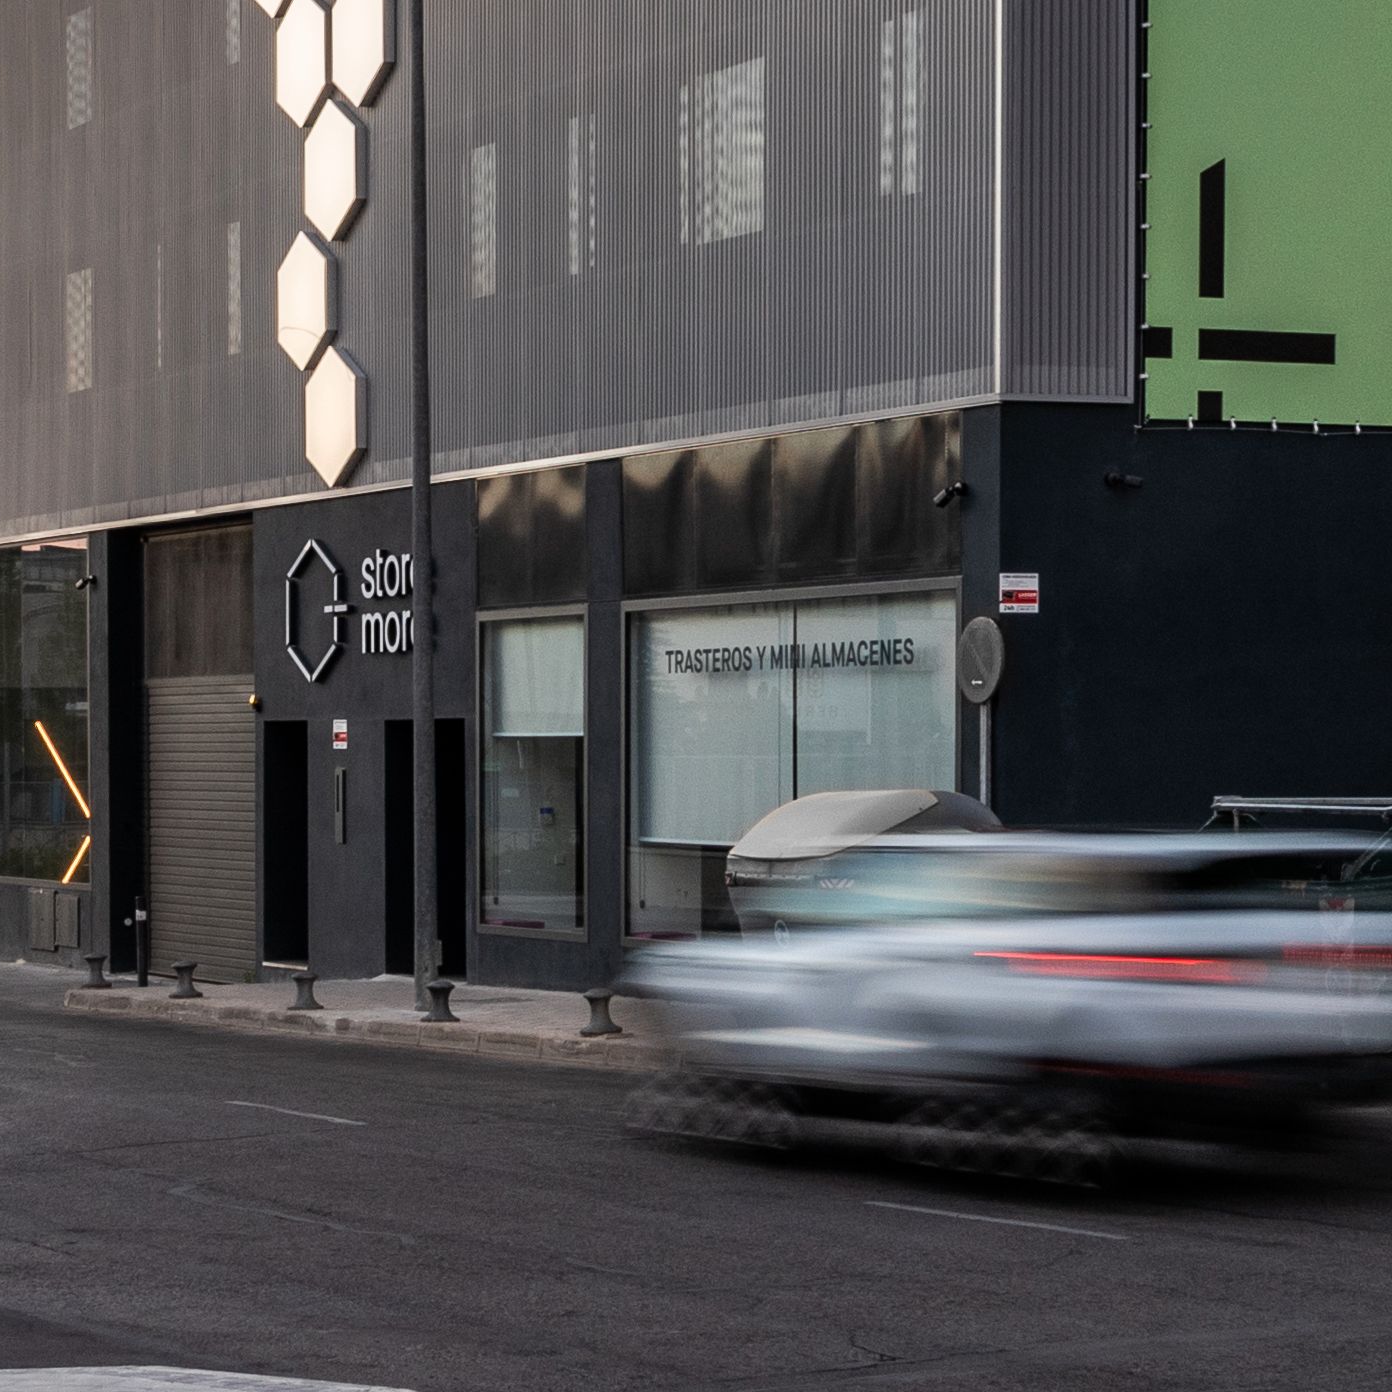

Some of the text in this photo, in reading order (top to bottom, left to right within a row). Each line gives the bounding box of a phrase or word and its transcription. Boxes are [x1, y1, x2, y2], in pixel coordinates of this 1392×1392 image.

[361, 549, 414, 599] stor
[361, 610, 414, 654] mor
[665, 638, 914, 674] TRASTEROS Y MINI ALMACENES
